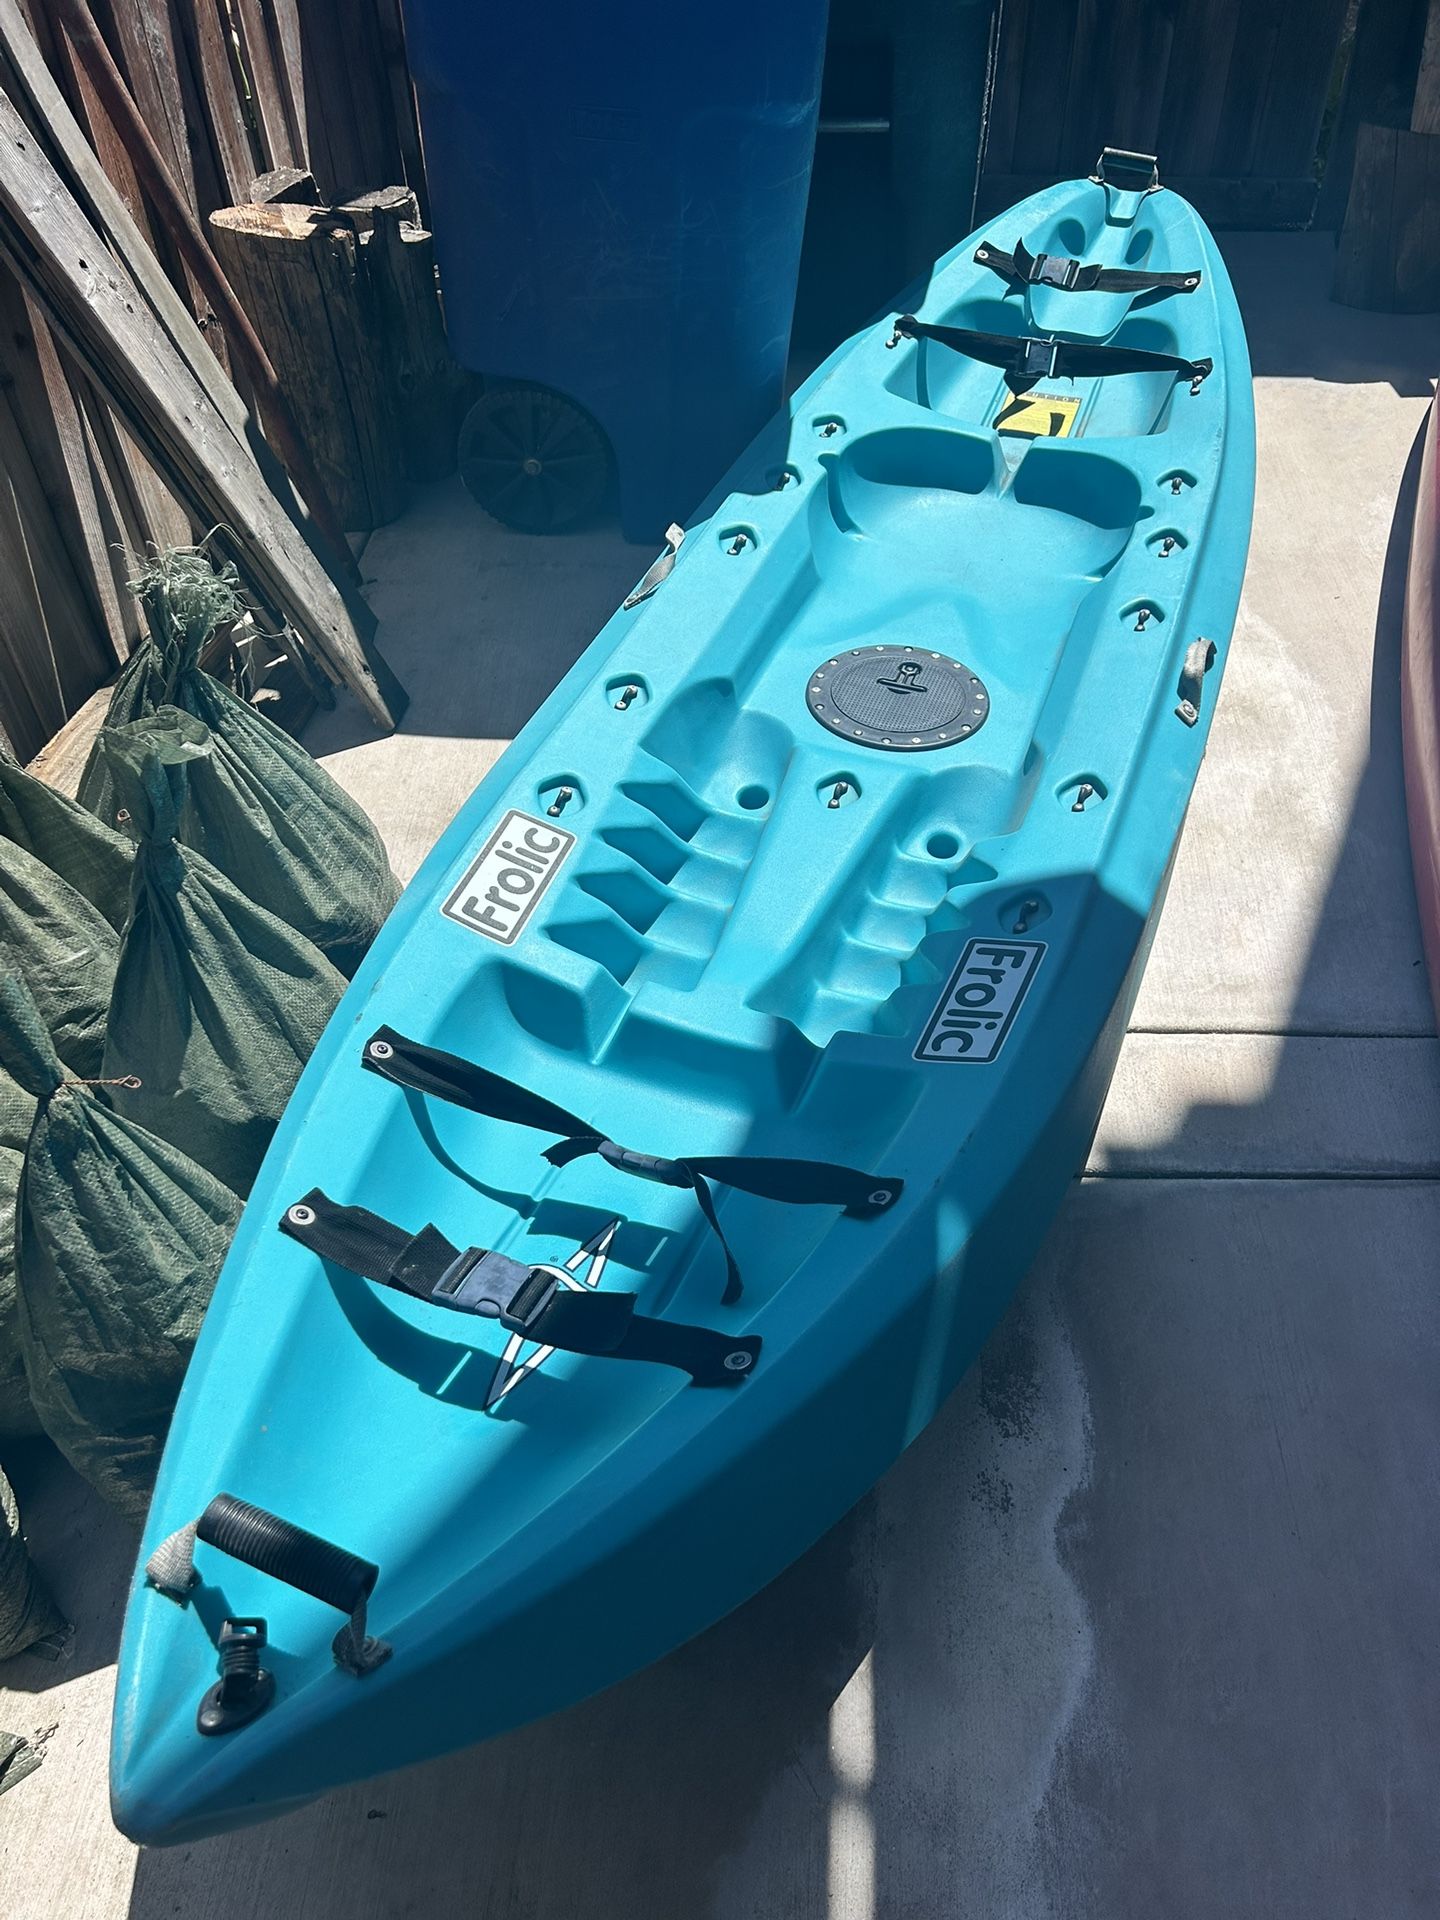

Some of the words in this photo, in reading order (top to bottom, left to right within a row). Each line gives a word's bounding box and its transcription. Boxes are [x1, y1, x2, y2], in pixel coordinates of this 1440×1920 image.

[1024, 391, 1081, 403] UTION
[461, 827, 561, 932] Frolic
[931, 947, 1027, 1053] Frolic
